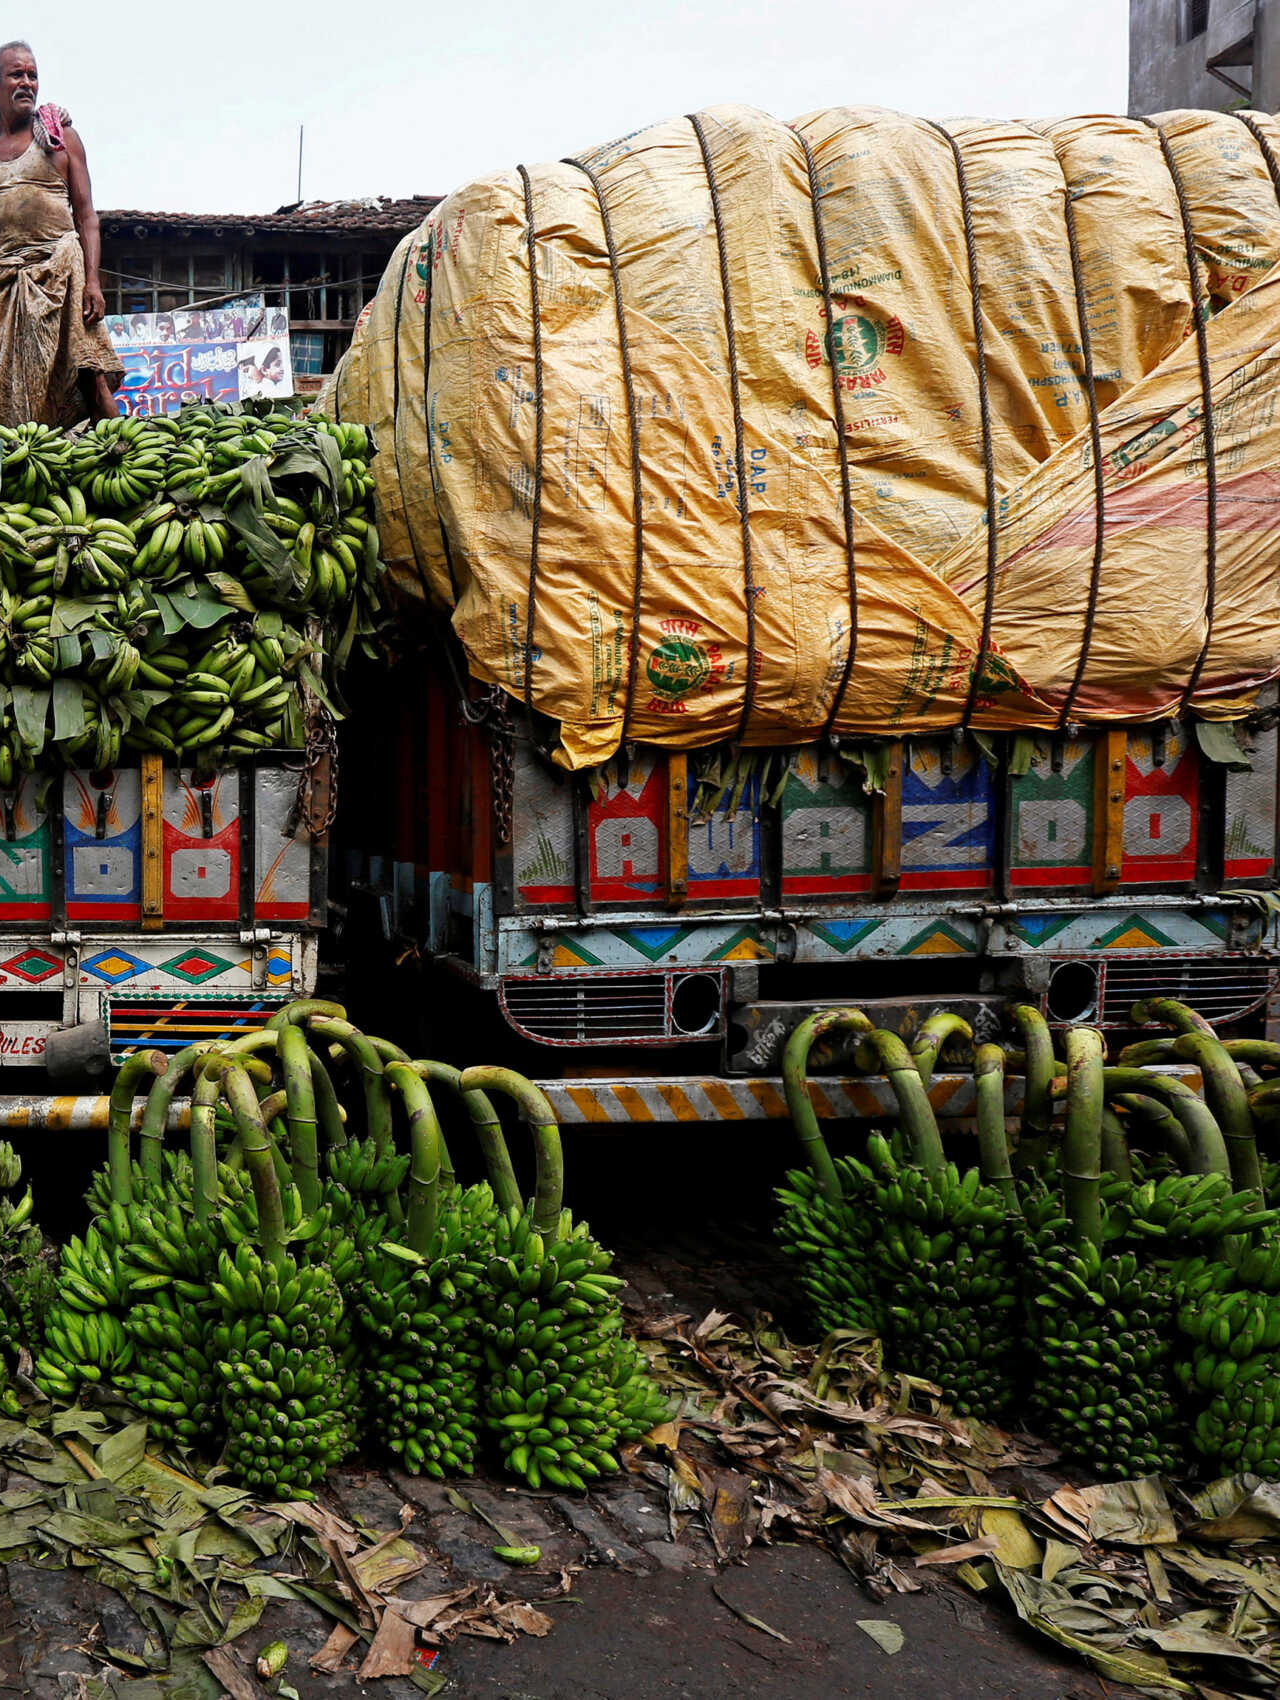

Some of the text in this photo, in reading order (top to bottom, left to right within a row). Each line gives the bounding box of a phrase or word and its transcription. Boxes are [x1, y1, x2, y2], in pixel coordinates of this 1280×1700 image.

[118, 346, 193, 390] Eid
[845, 414, 900, 433] FERTILISE
[751, 449, 767, 496] D.A.P.
[658, 619, 702, 637] पारस
[594, 794, 1192, 878] AWAZ DO
[73, 845, 232, 898] DO
